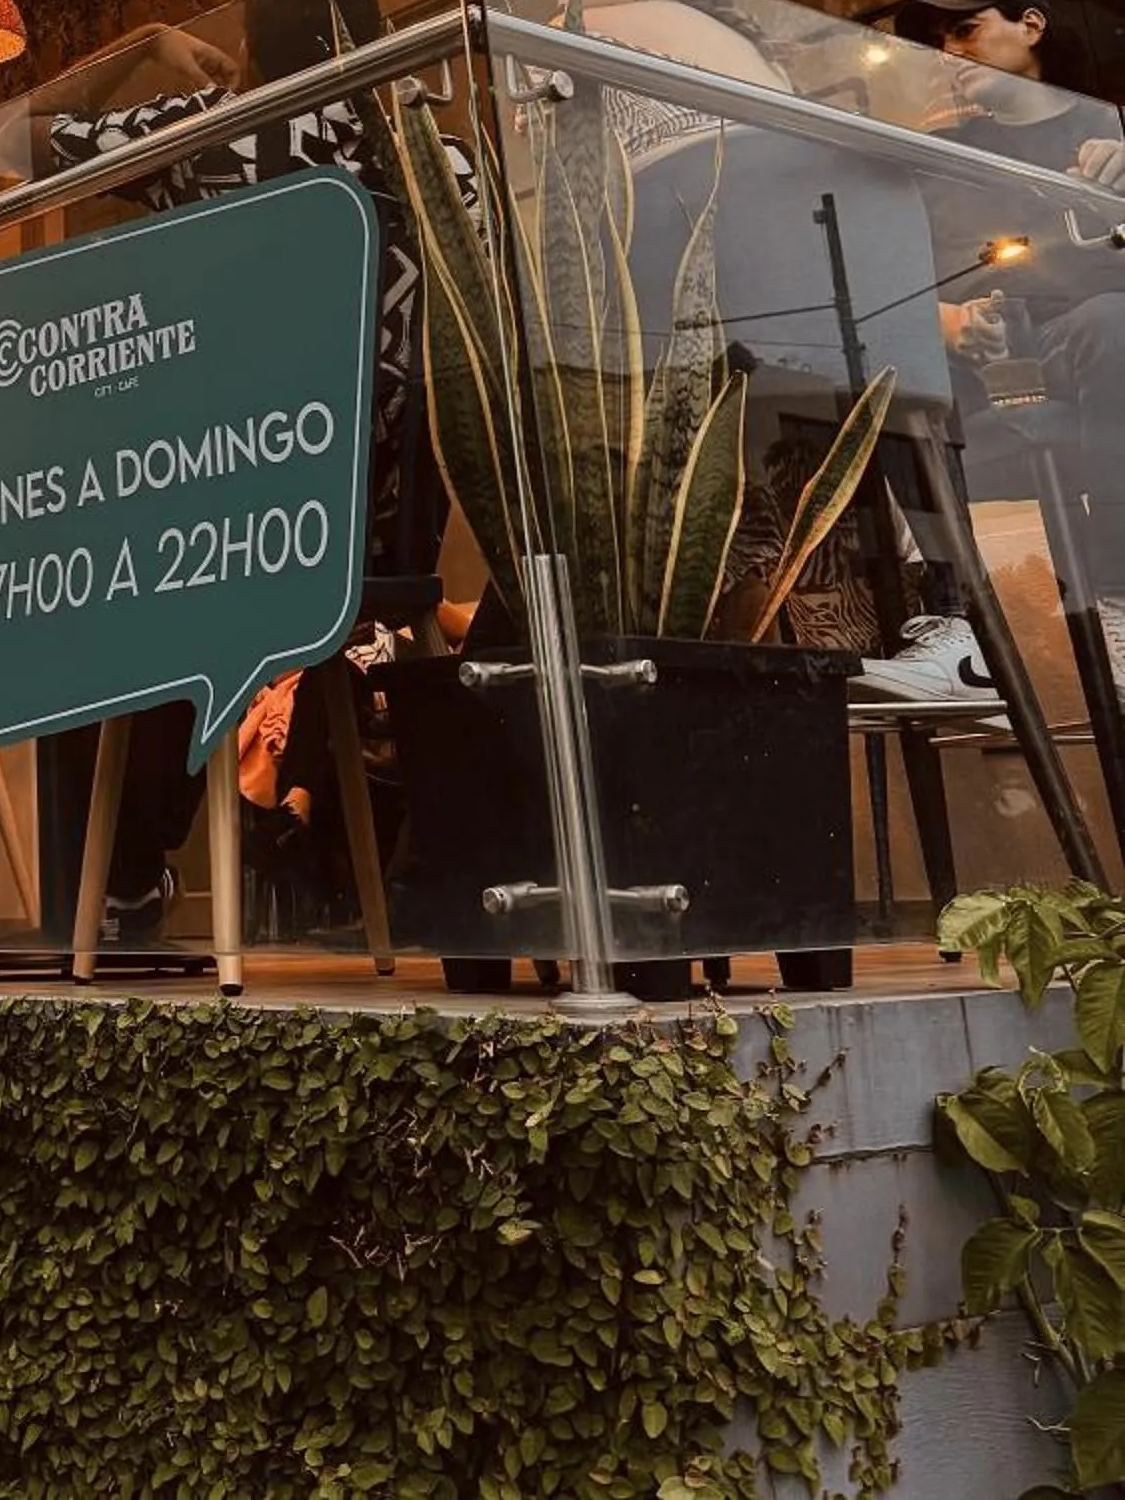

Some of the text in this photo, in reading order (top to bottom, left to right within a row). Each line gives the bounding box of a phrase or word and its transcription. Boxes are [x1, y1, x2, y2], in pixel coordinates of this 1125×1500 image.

[18, 293, 149, 364] CONTRA
[30, 320, 196, 397] CORRIENTE
[77, 459, 105, 507] A
[115, 401, 334, 497] DOMINGO
[106, 538, 139, 600] A
[154, 500, 329, 593] 22H00
